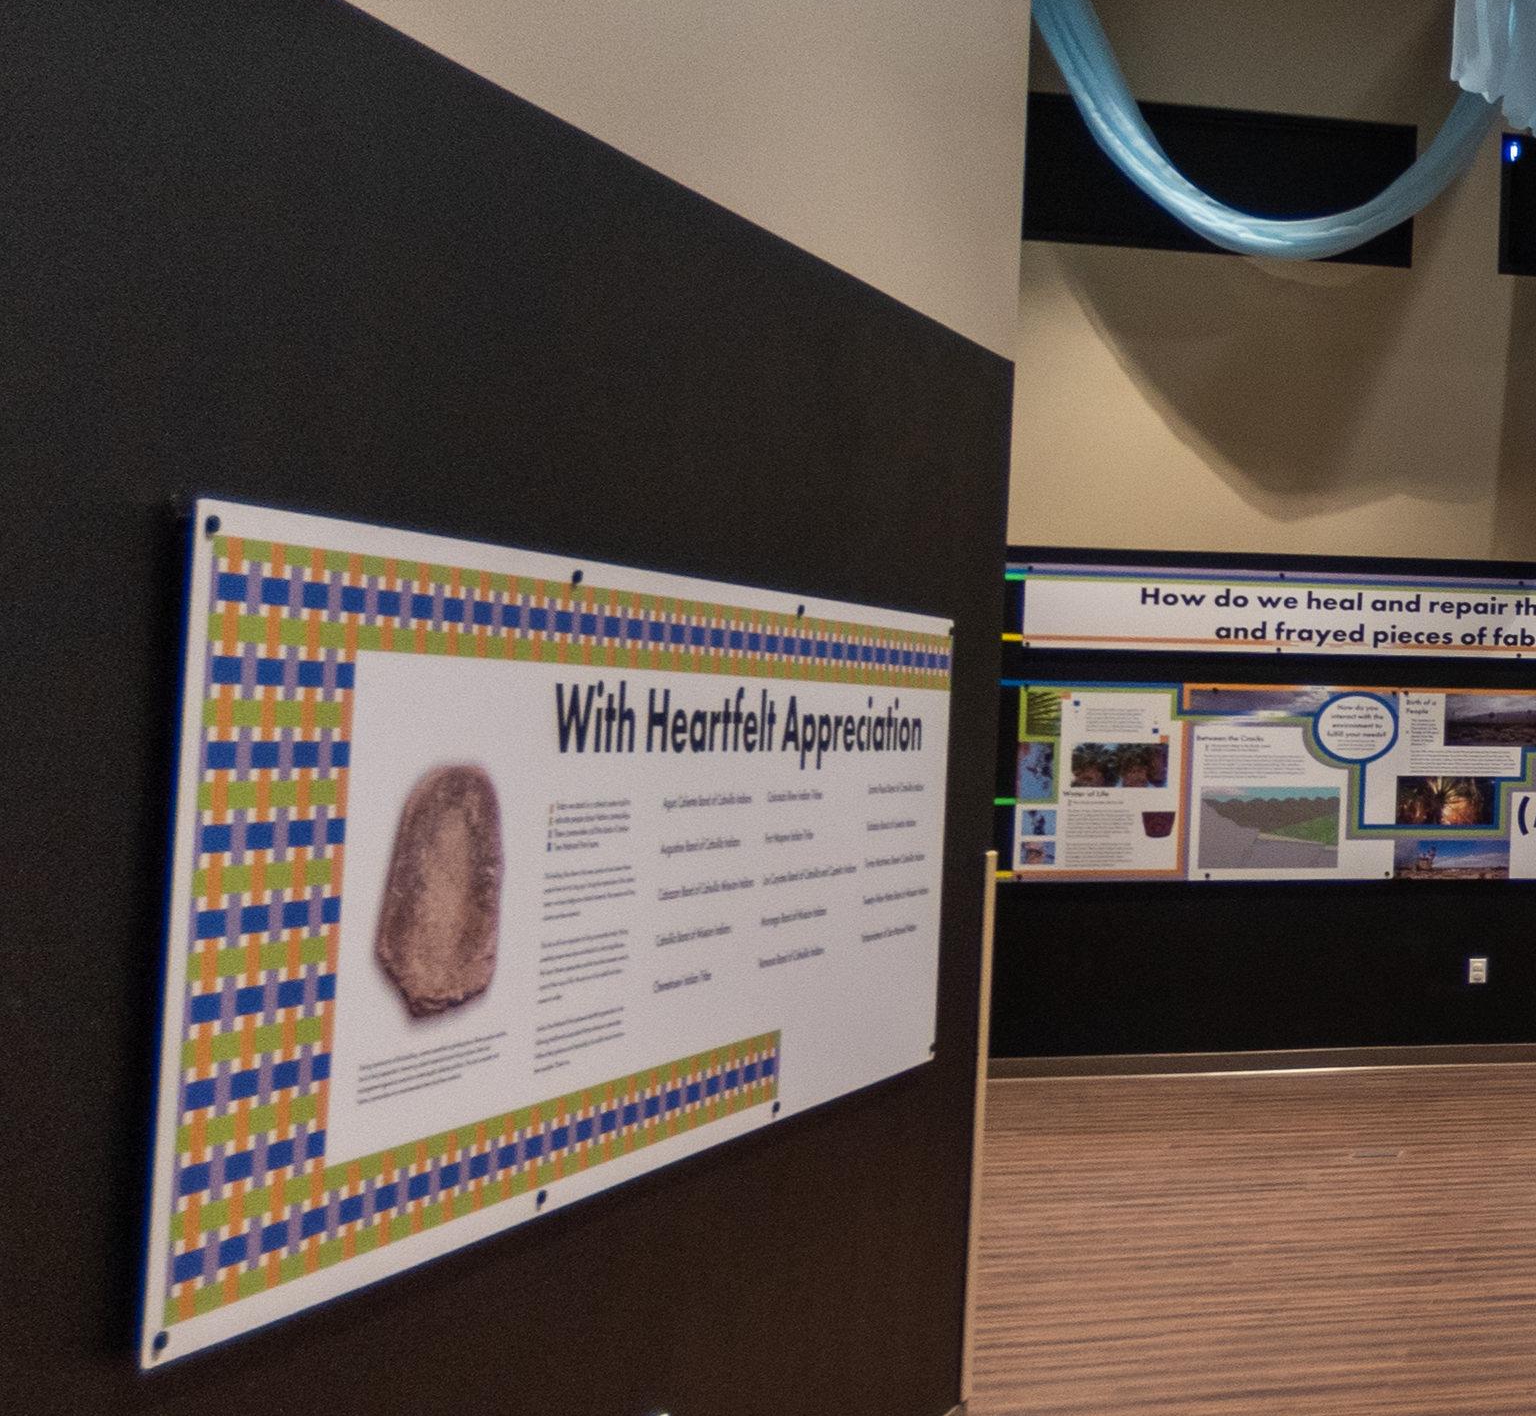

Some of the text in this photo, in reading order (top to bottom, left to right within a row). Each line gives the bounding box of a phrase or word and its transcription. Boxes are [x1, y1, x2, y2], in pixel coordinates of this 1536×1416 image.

[1140, 587, 1205, 606] How
[1214, 588, 1248, 608] do
[1257, 596, 1298, 609] we
[1306, 590, 1363, 611] heal
[1370, 587, 1421, 612] and
[1429, 589, 1510, 619] repair
[1215, 621, 1266, 643] and
[1275, 621, 1364, 652] frayed
[1372, 624, 1457, 649] pieces
[1459, 626, 1489, 650] of
[555, 680, 921, 770] With Heartfelt Appreciation
